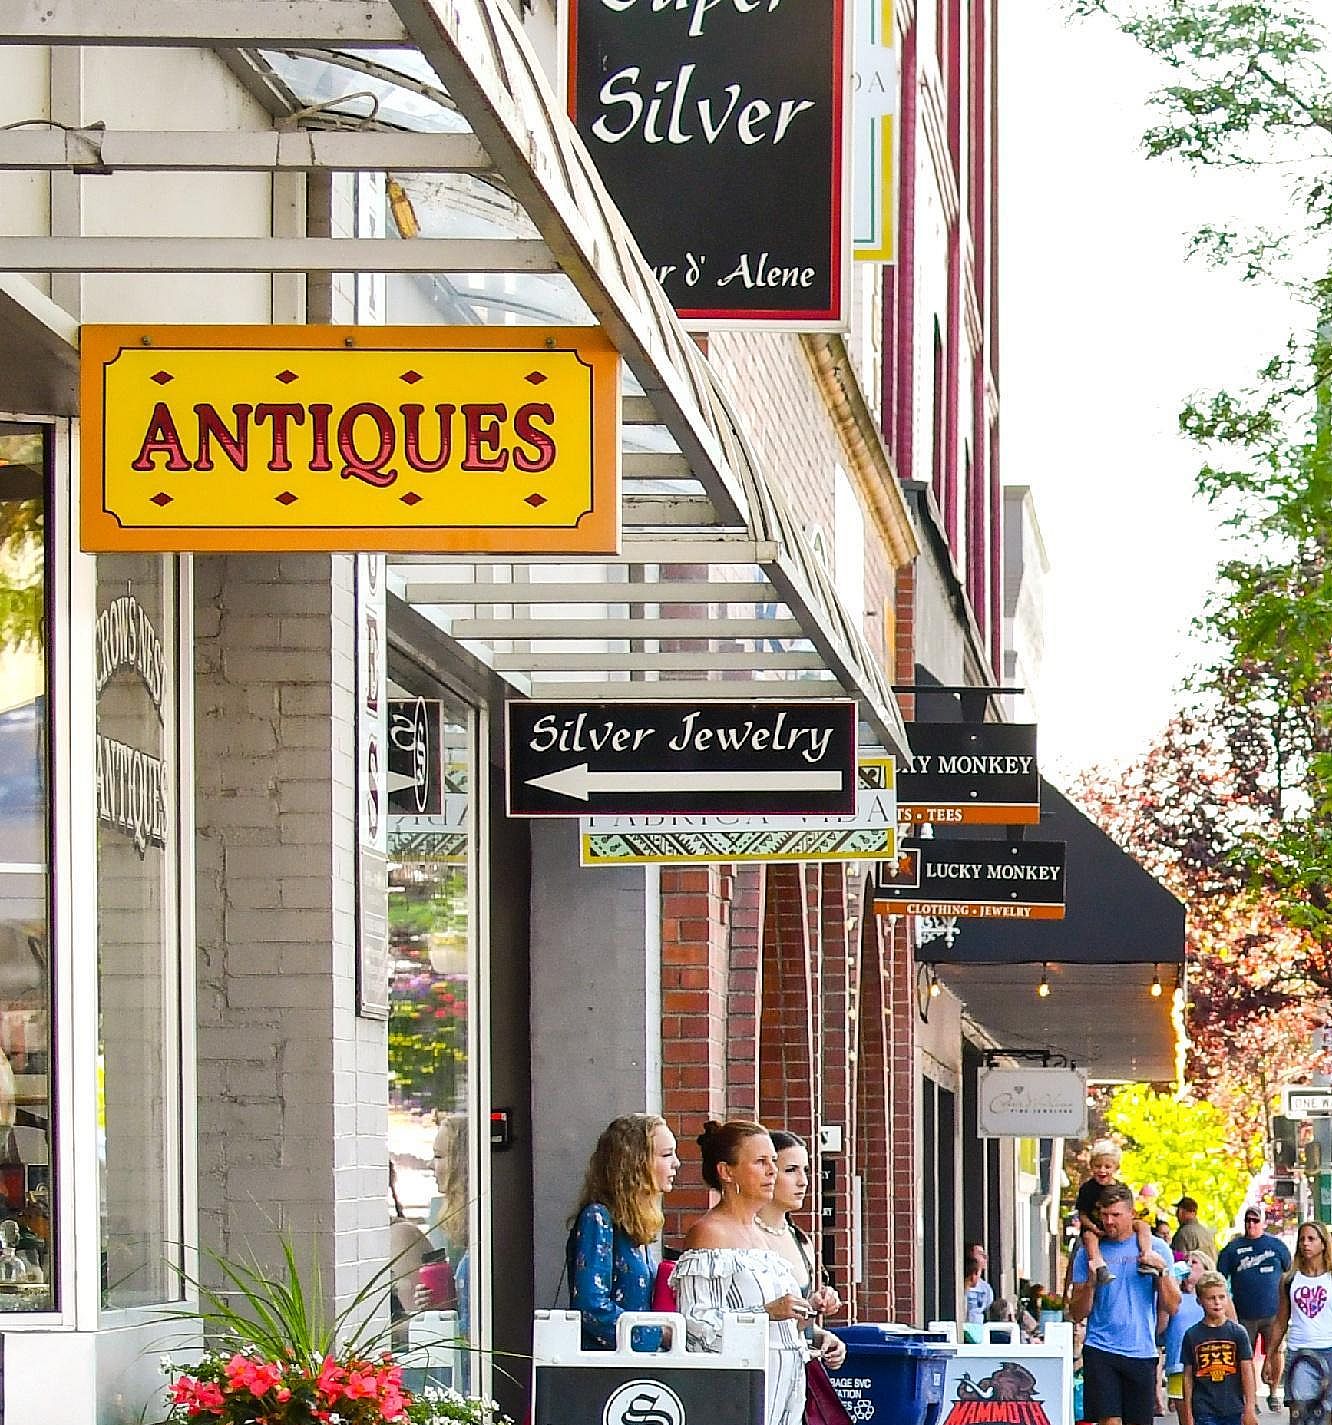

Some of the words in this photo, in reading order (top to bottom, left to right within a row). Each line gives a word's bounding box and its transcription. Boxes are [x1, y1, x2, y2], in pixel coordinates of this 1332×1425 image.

[591, 63, 816, 145] Silver
[717, 252, 816, 289] Alene
[131, 402, 556, 488] ANTIQUES
[529, 712, 656, 752] Silver
[668, 711, 834, 763] Jewelry
[938, 756, 1034, 775] MONKEY
[927, 808, 963, 822] TEES
[926, 862, 983, 879] LUCKY
[986, 864, 1061, 881] MONKEY
[906, 903, 970, 916] CLOTHING
[979, 904, 1032, 917] JEWELRY
[1295, 1098, 1318, 1108] ONE
[854, 1377, 872, 1388] SVC
